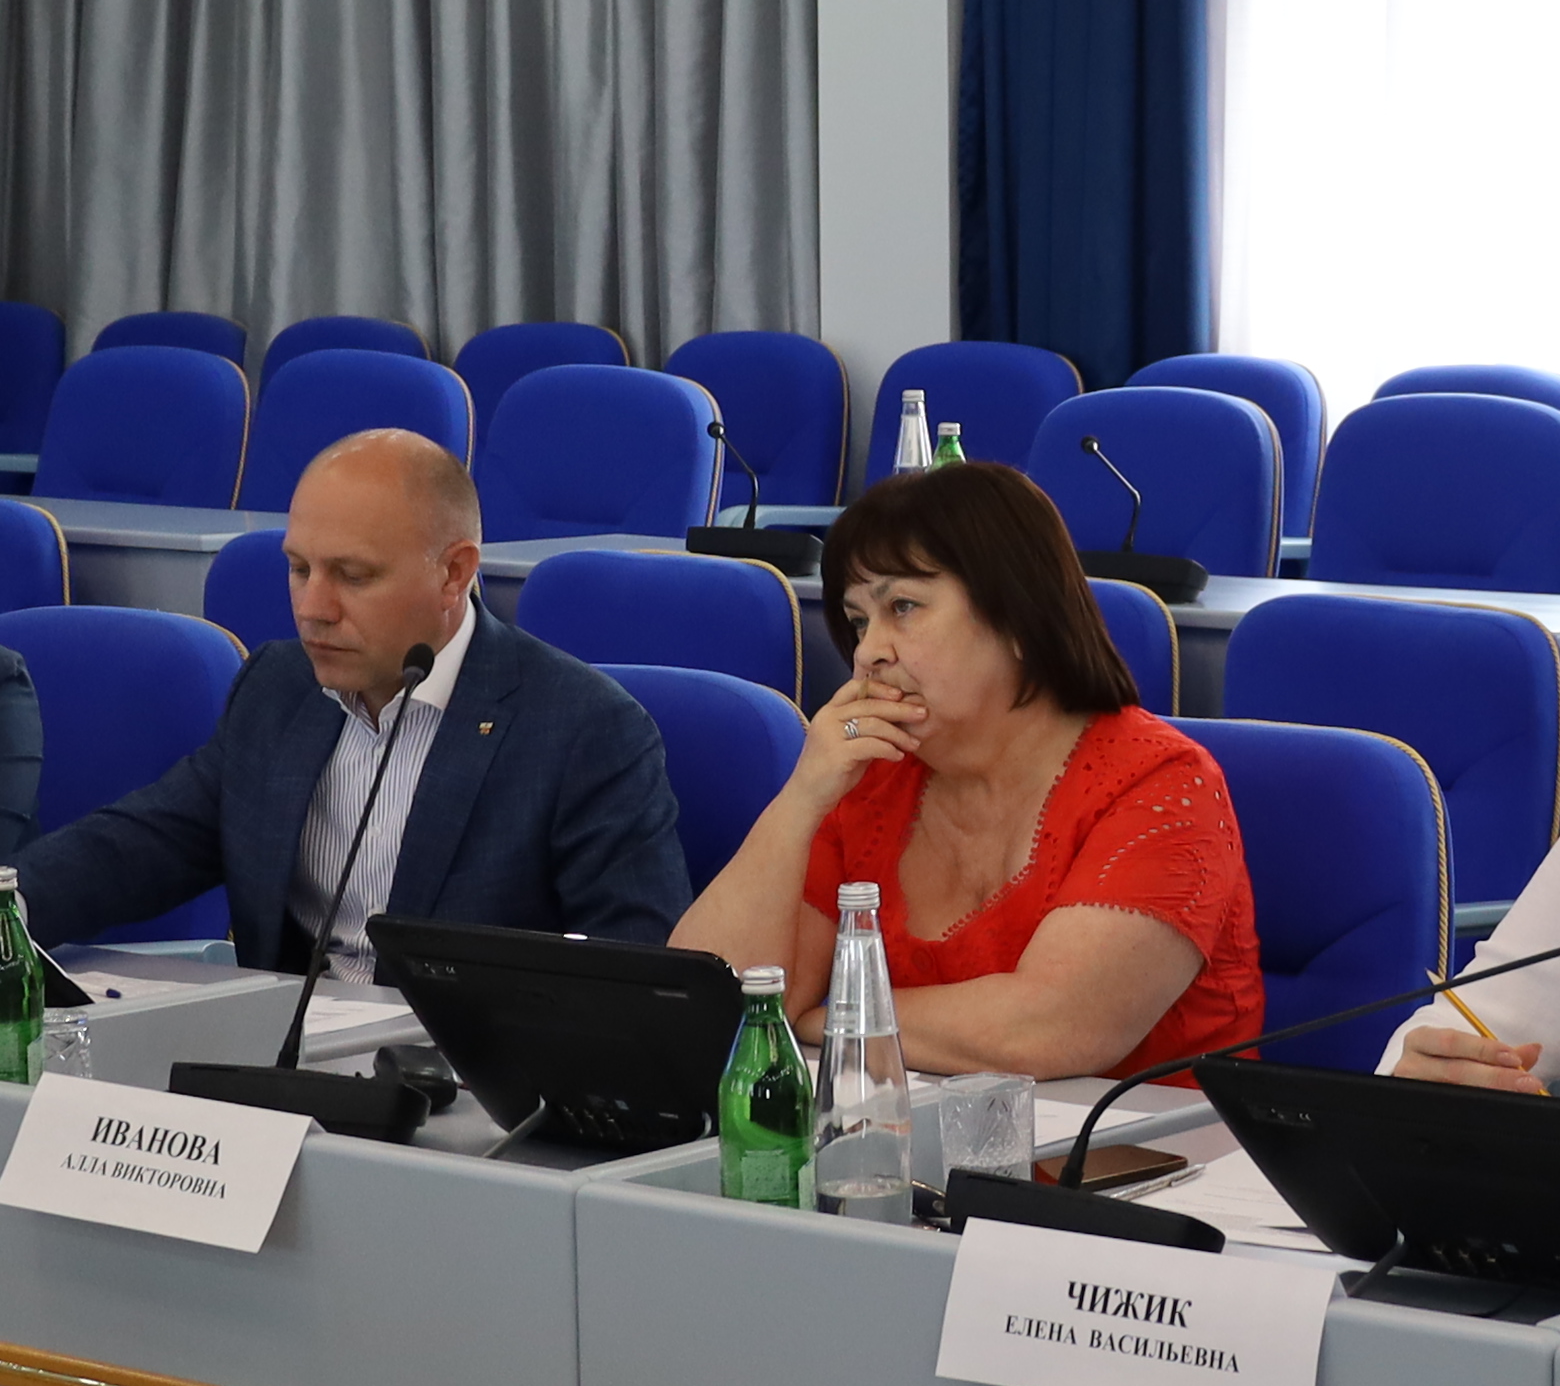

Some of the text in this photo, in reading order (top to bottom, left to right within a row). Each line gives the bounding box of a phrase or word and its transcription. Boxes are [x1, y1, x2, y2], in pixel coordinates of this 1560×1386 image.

[90, 1116, 220, 1165] ИВАНОВА
[60, 1152, 226, 1199] АЛЛА ВИКТОРОВНА
[1068, 1281, 1192, 1328] ЧИЖИК
[1005, 1315, 1239, 1373] ЕЛЕНА ВАСИЛЬЕВНА
